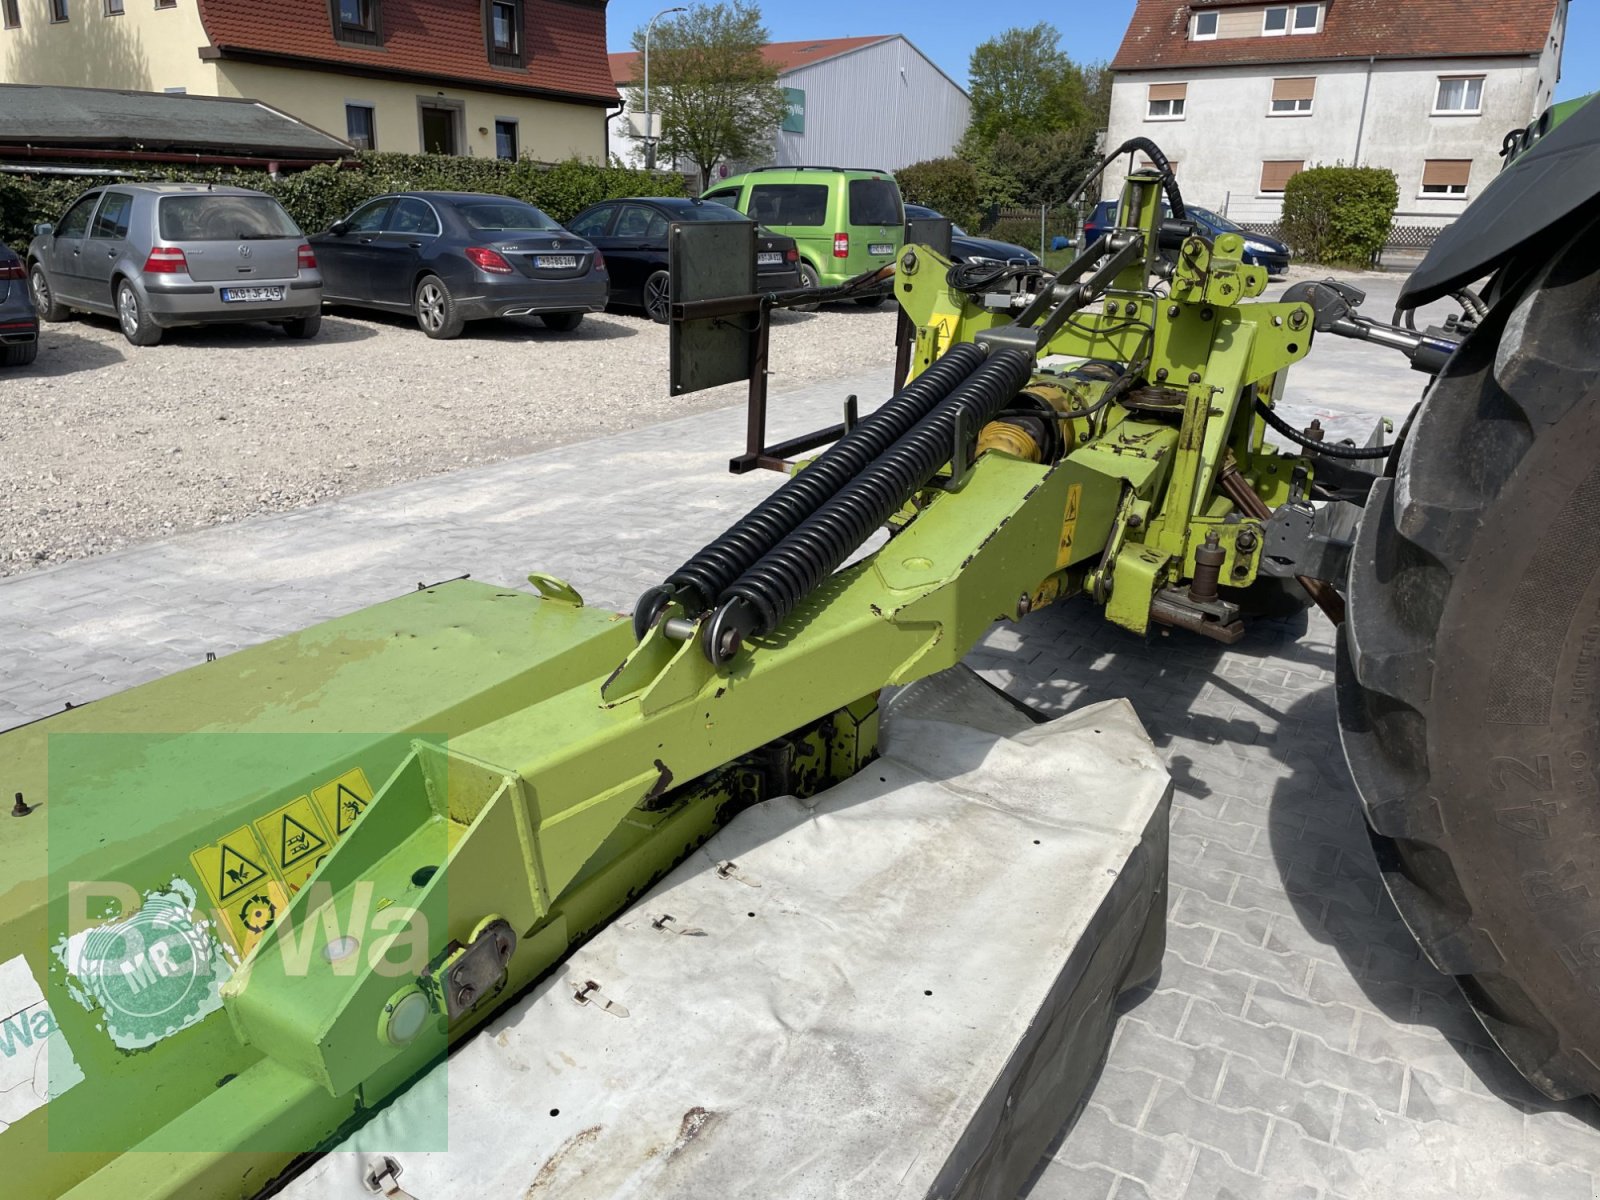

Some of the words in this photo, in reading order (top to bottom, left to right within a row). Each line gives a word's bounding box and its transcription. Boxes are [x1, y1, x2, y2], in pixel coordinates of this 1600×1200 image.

[229, 288, 247, 299] DKB
[252, 288, 262, 298] JF
[263, 287, 280, 298] 245
[1488, 754, 1560, 841] 42
[120, 941, 179, 995] MR
